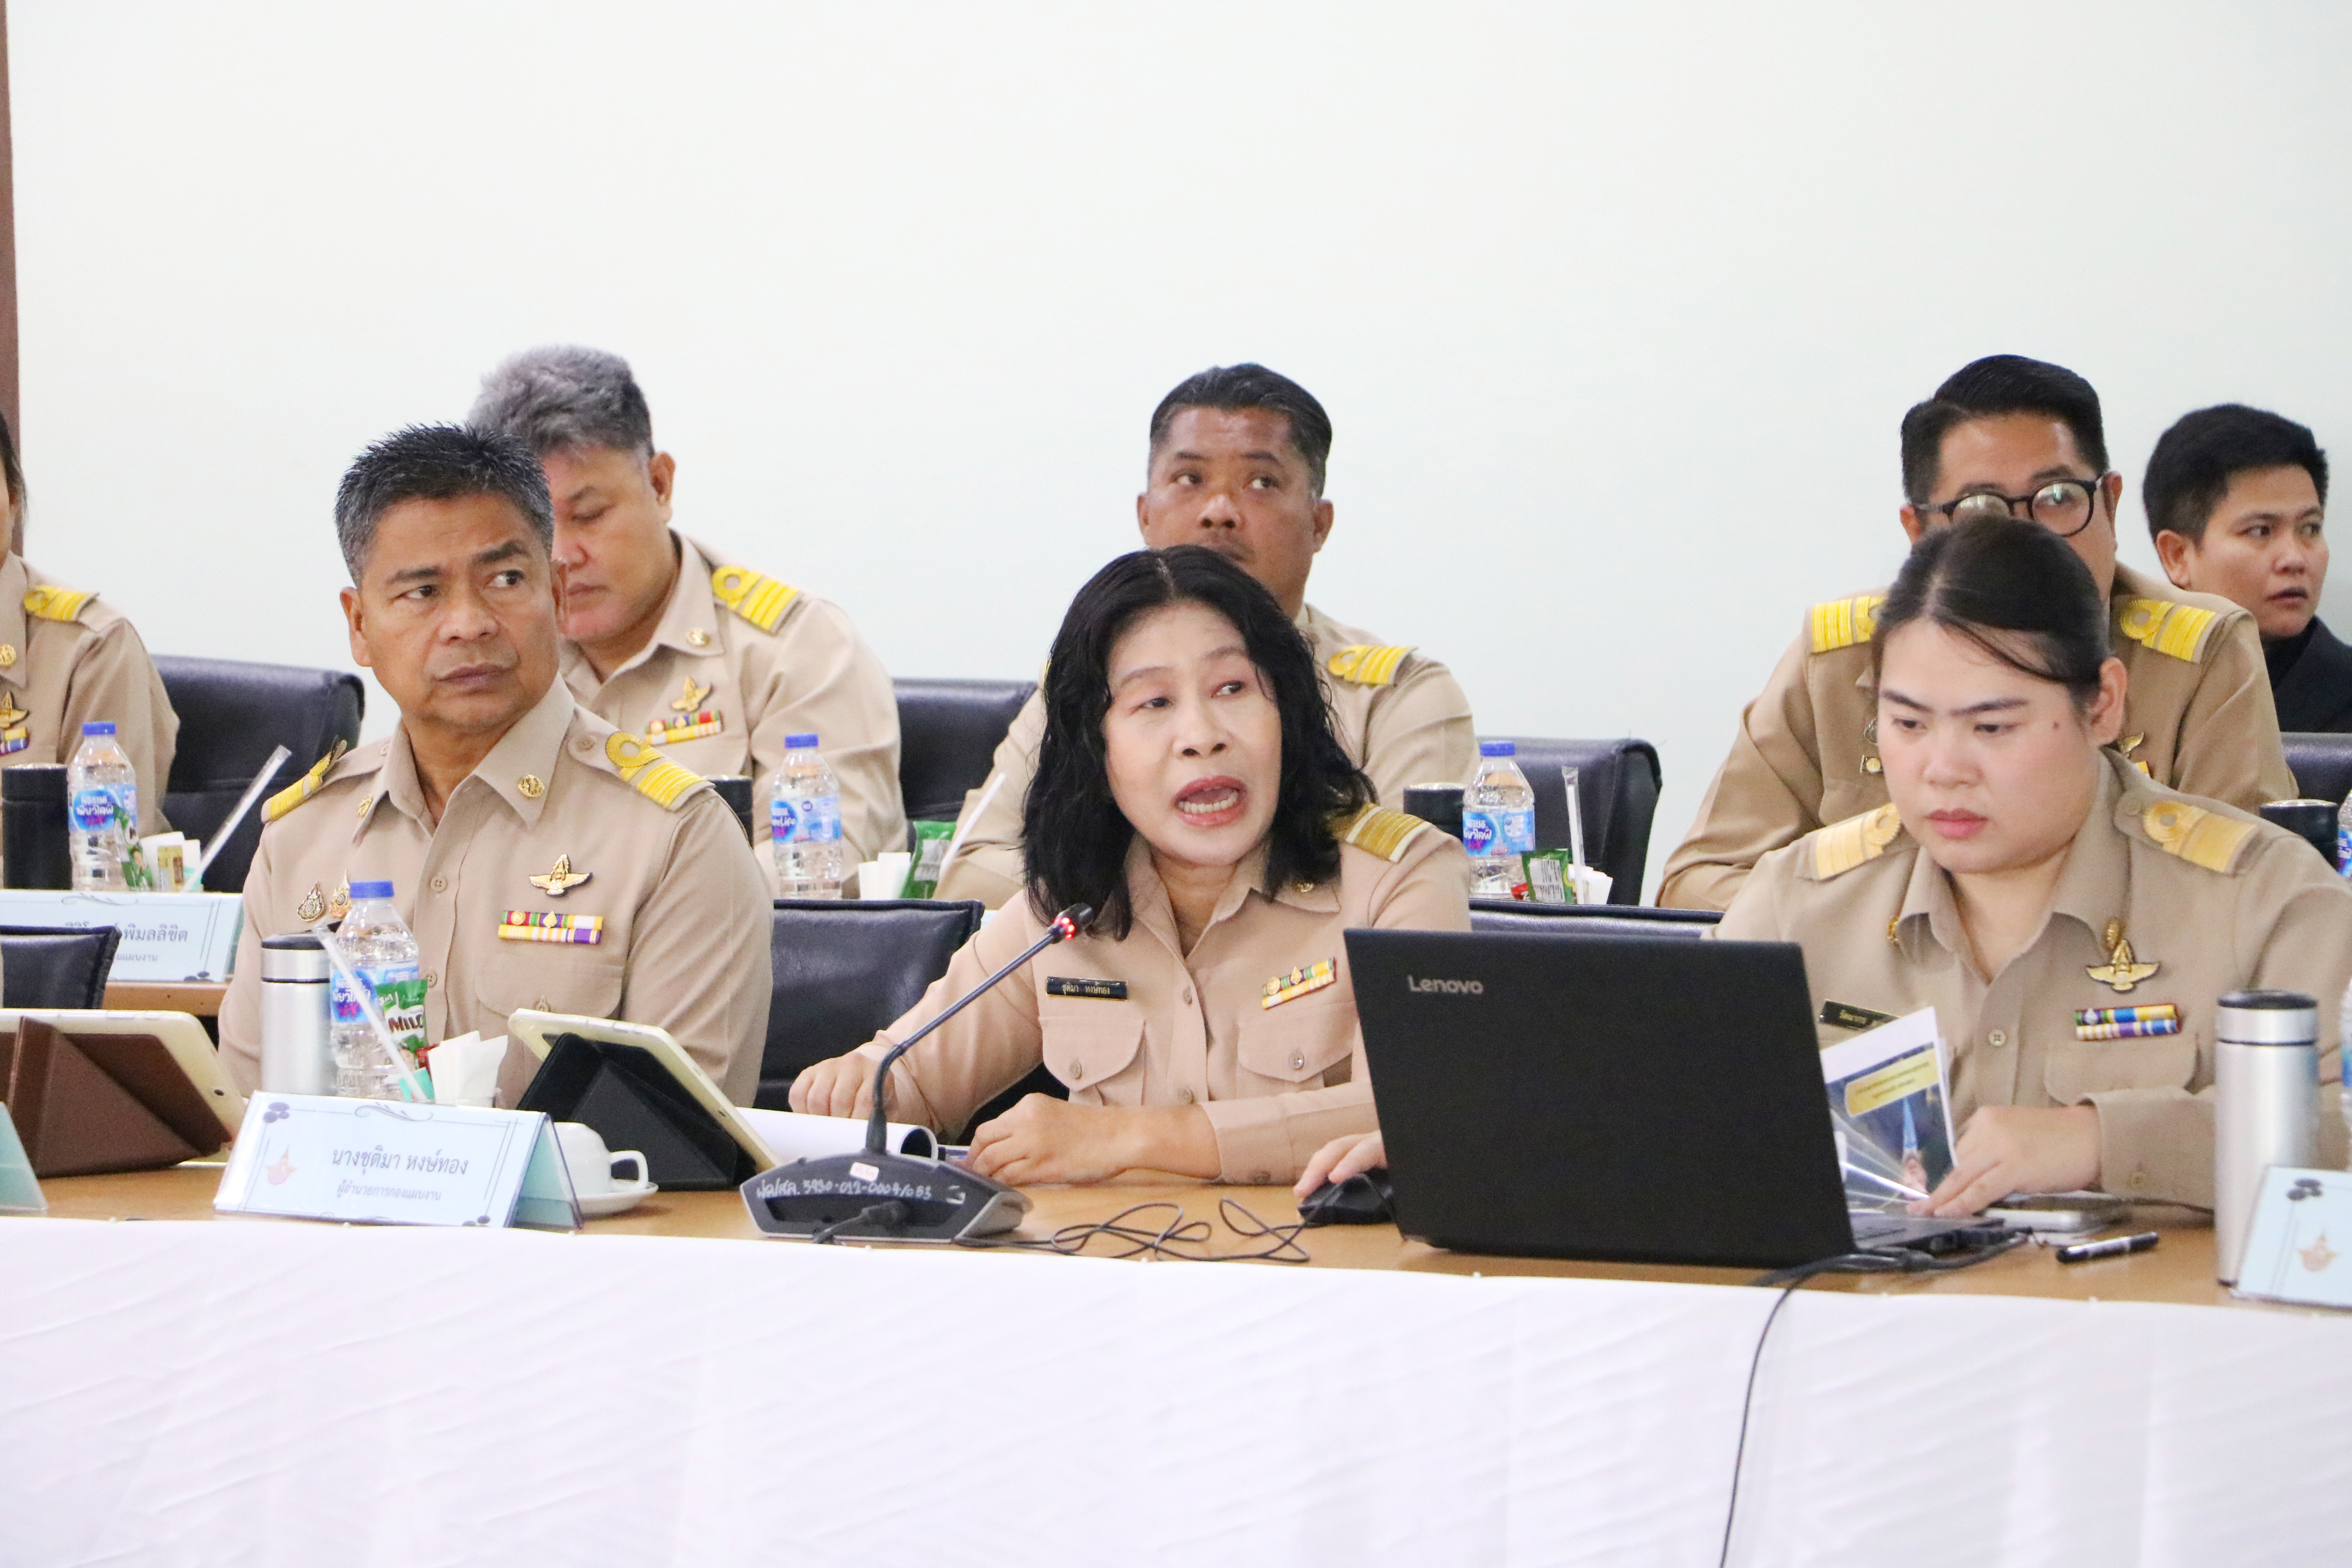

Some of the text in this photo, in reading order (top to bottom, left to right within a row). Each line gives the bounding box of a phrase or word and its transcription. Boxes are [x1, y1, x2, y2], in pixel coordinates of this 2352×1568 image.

[1407, 975, 1484, 994] Lenovo
[332, 1145, 469, 1175] นางชุติมา หงษ์ทอง
[337, 1179, 442, 1201] ผู้อำนวยการกองแผนงาน
